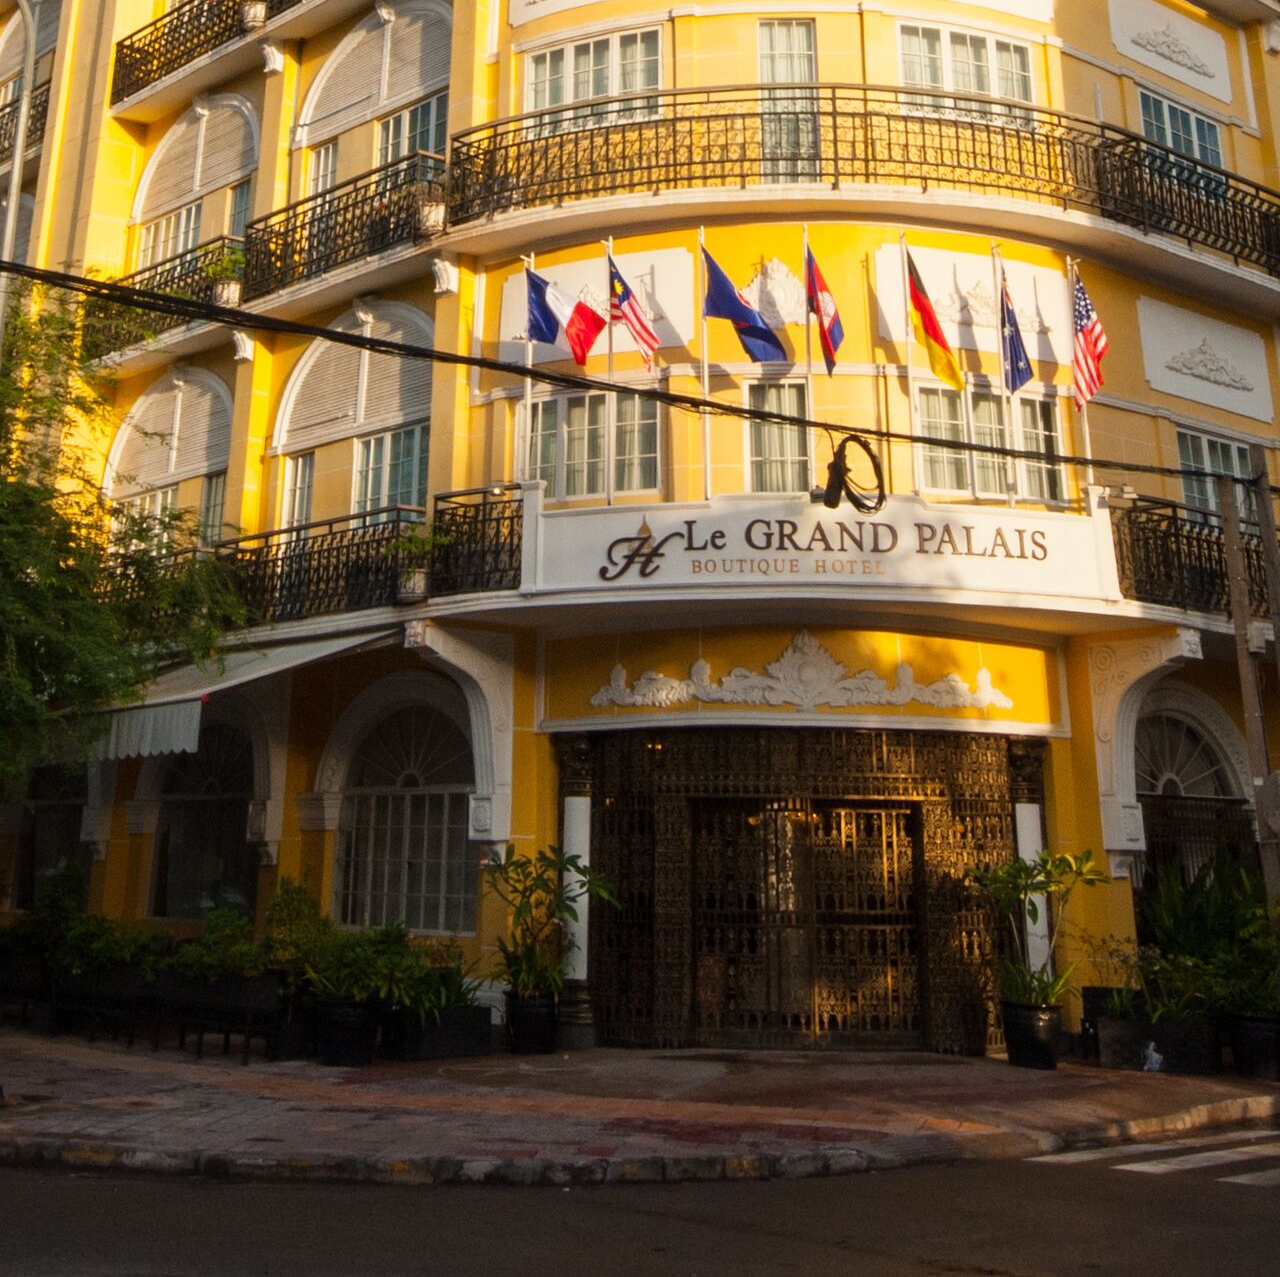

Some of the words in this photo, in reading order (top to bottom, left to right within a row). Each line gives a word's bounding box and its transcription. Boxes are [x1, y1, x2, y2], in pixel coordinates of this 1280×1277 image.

[684, 519, 727, 551] Le
[744, 519, 899, 554] GRAND
[914, 522, 1049, 561] PALAIS
[691, 559, 800, 577] BOUTIQUE
[814, 559, 887, 576] HOTEL
